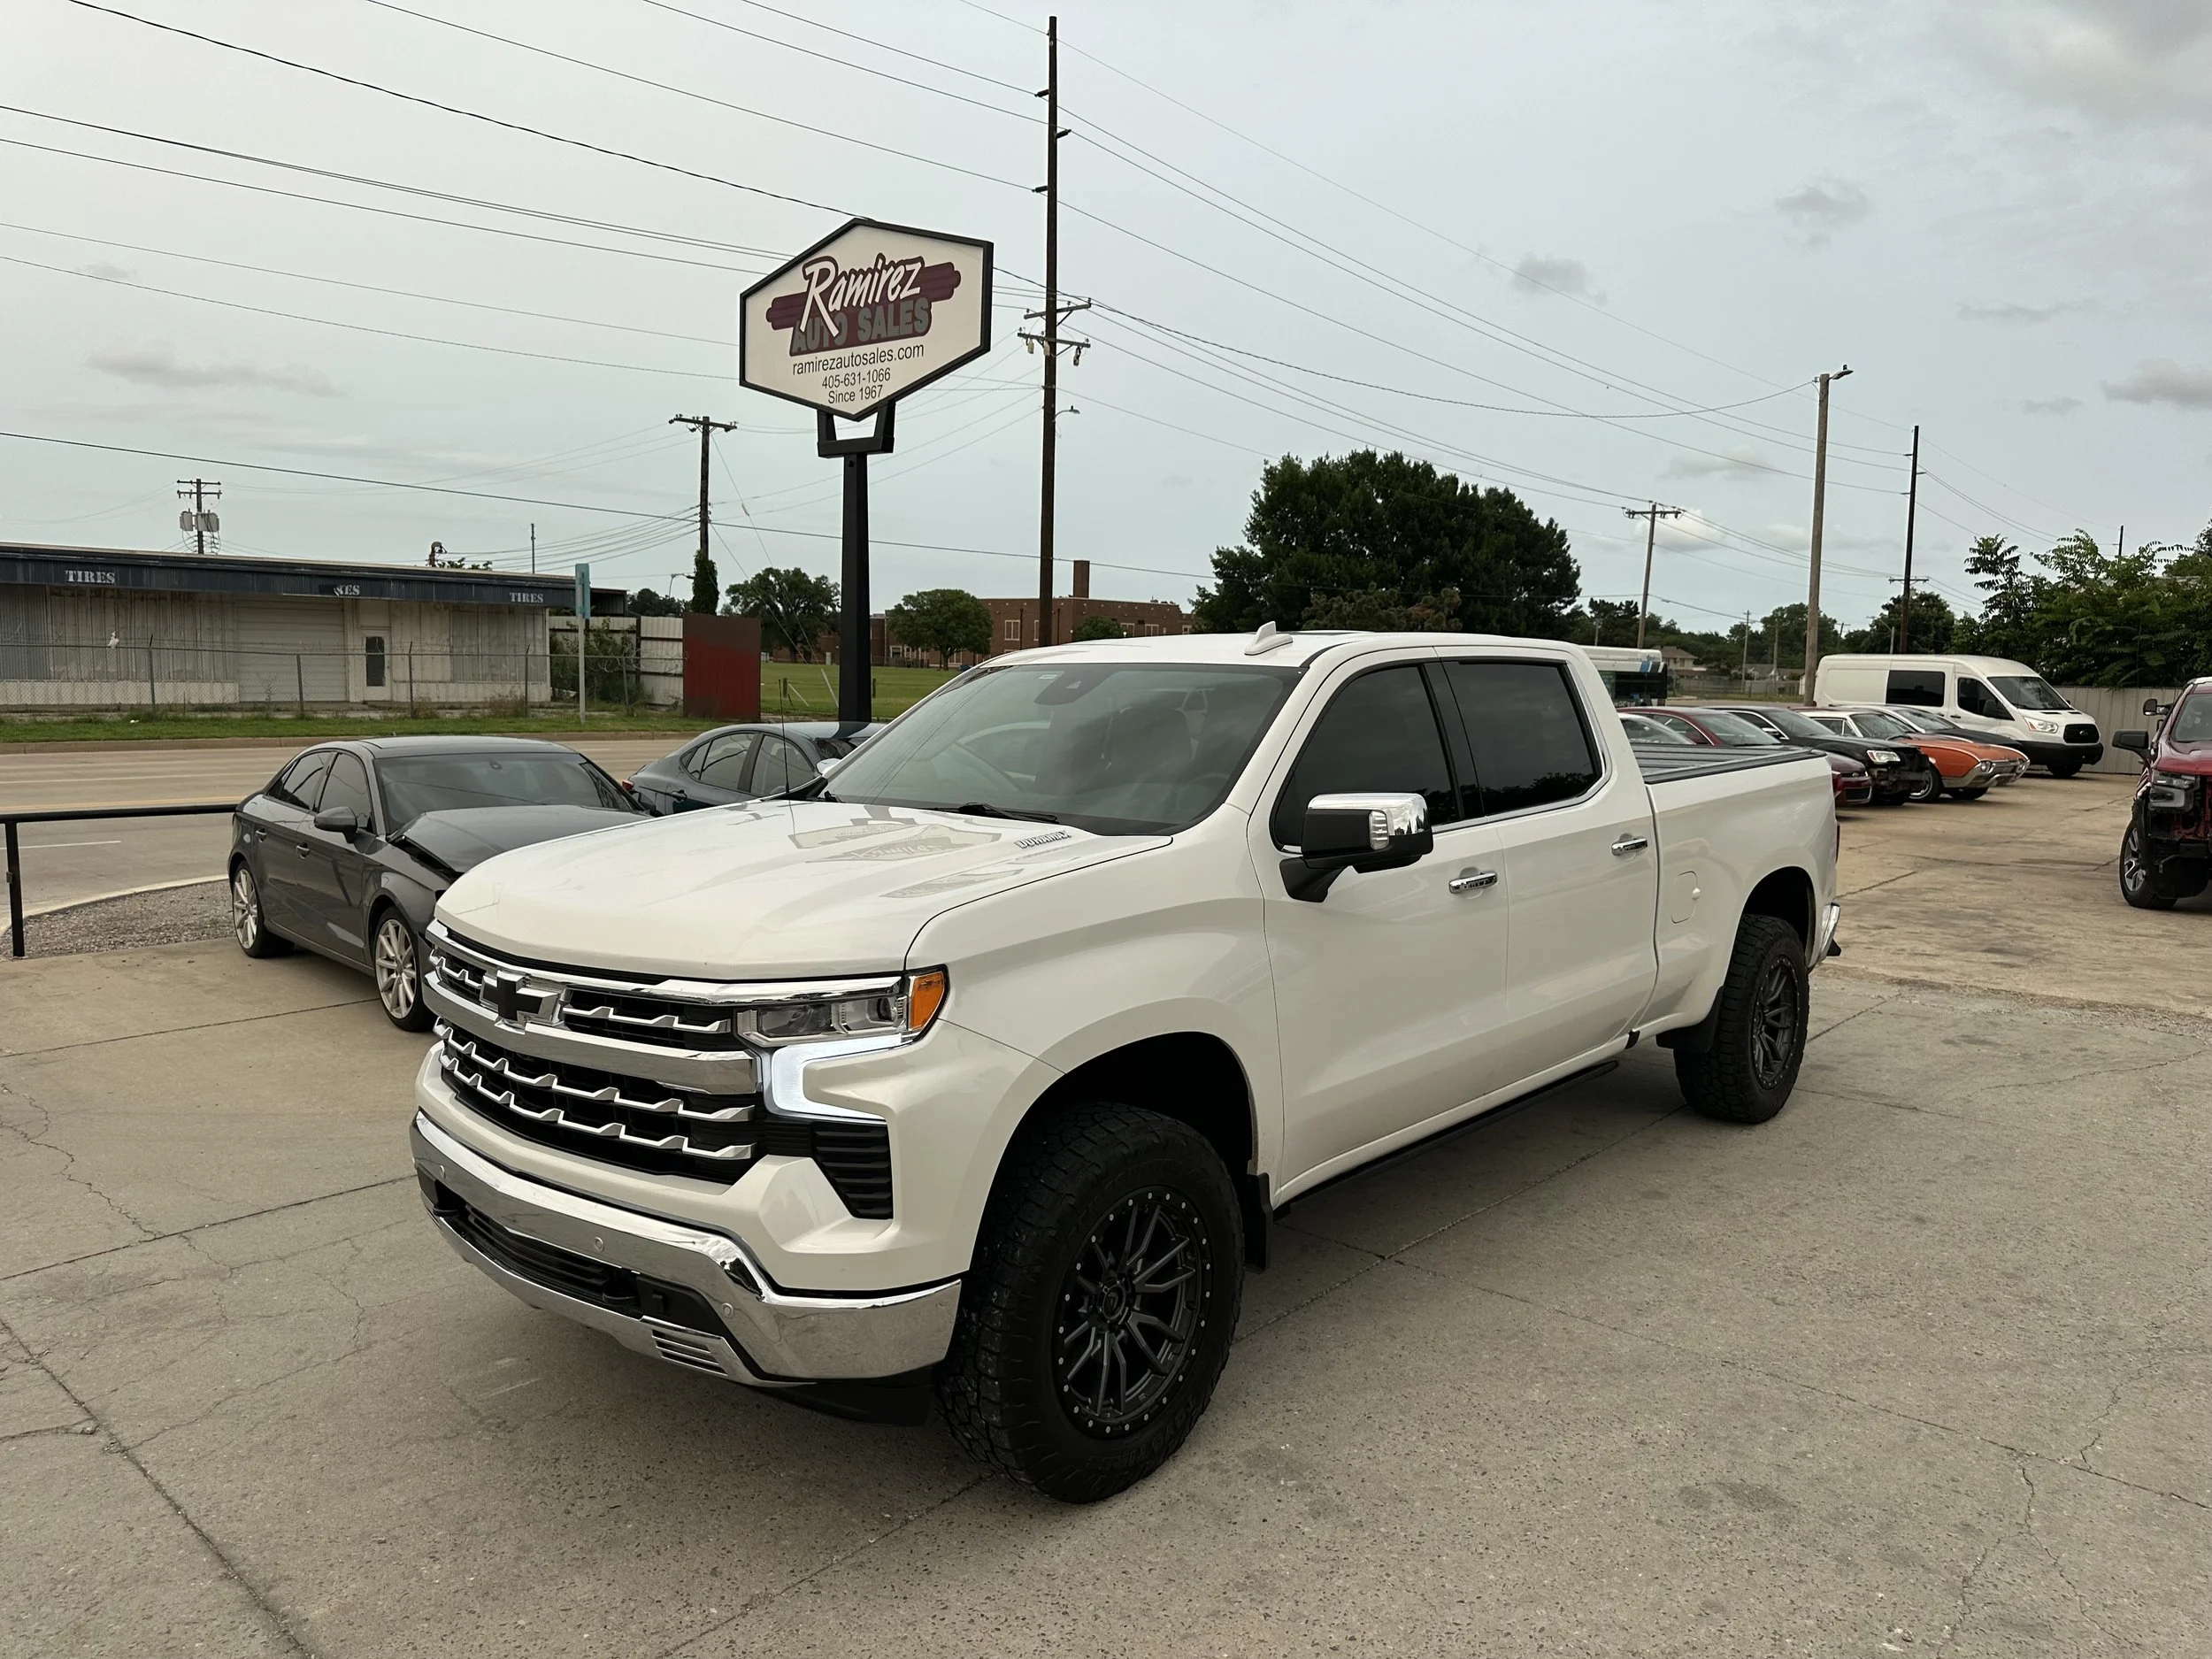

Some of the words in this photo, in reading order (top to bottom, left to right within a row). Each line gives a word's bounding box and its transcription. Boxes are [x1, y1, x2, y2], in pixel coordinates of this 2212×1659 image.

[800, 258, 922, 337] Ramirez
[792, 311, 849, 353] AUTO
[857, 297, 930, 342] SALES
[792, 343, 925, 375] ramirezautosales.com
[822, 367, 891, 389] 405-631-1066
[828, 390, 856, 404] Since
[859, 385, 883, 400] 1967
[65, 570, 116, 584] TIRES
[509, 592, 544, 603] TIRES
[1014, 830, 1072, 849] DURAMAX
